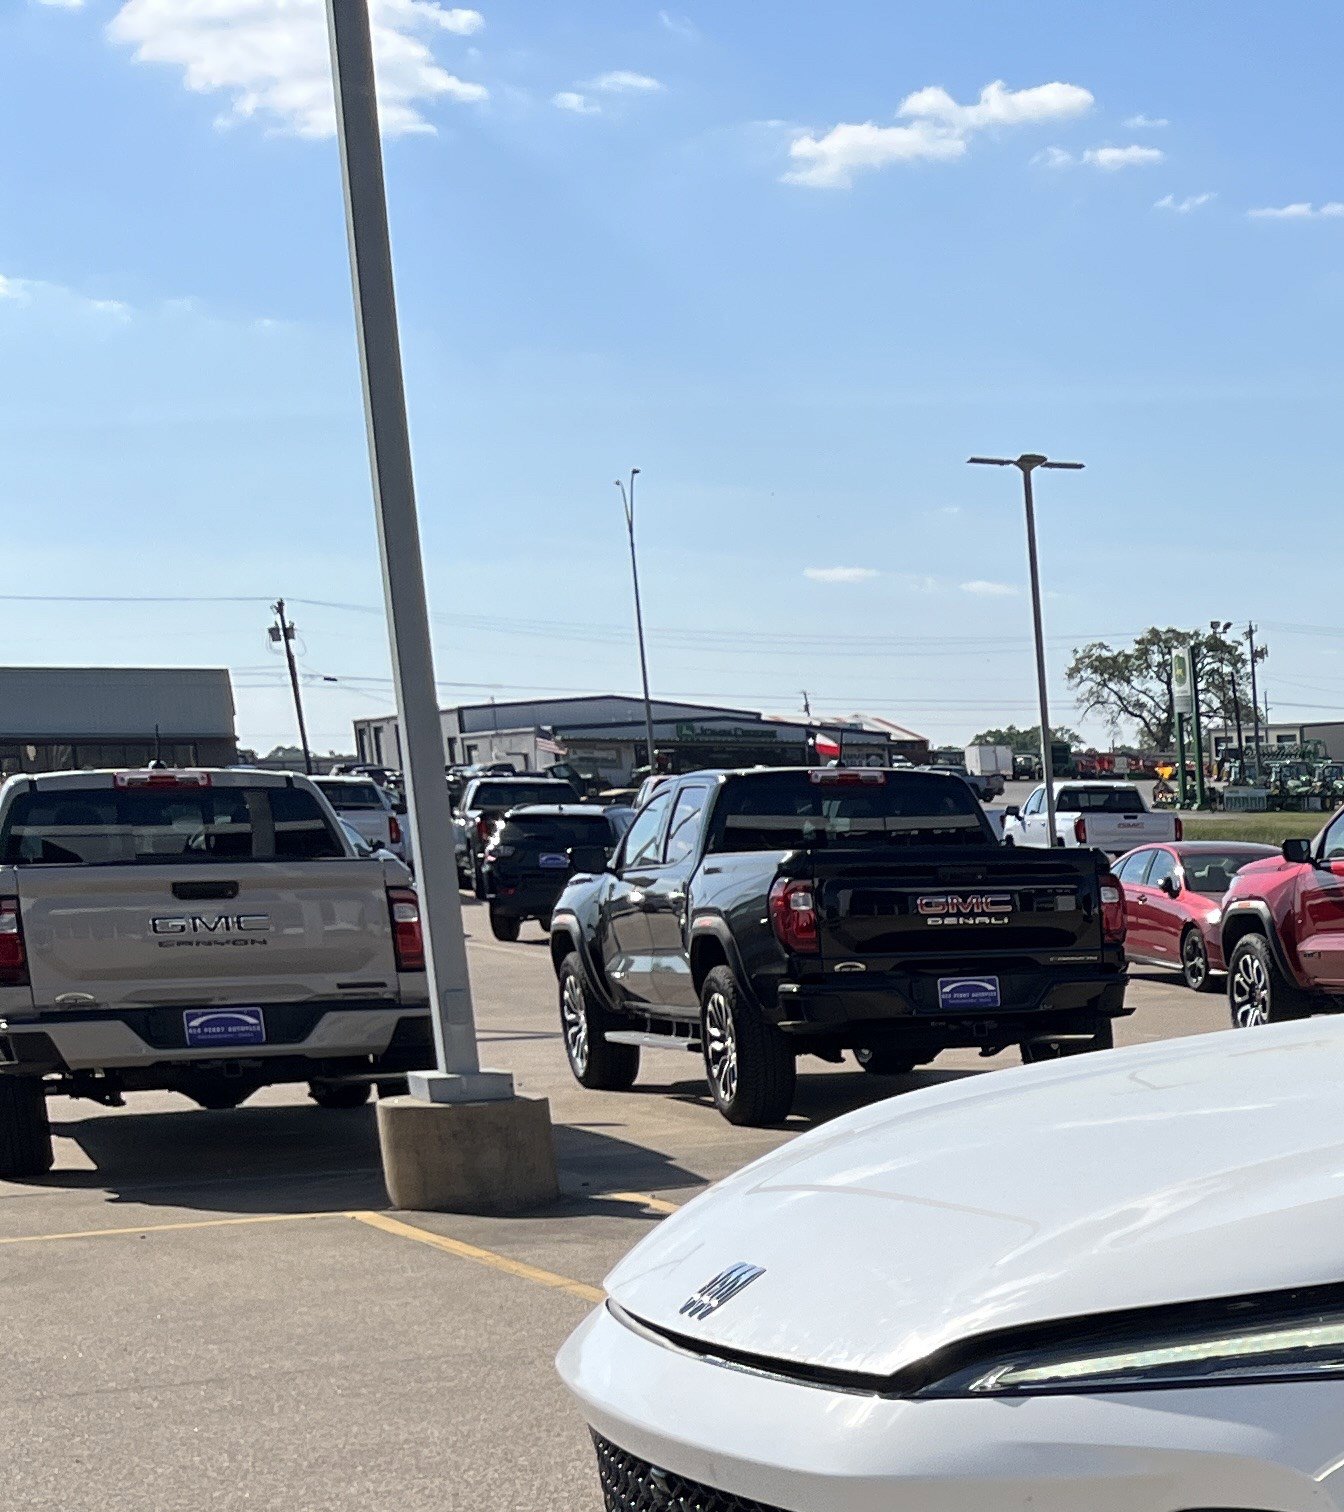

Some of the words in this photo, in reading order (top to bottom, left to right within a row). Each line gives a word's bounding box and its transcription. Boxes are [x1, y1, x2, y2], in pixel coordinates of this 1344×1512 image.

[916, 894, 1013, 915] GMC
[149, 915, 271, 934] GMC
[926, 916, 1009, 926] DENALI
